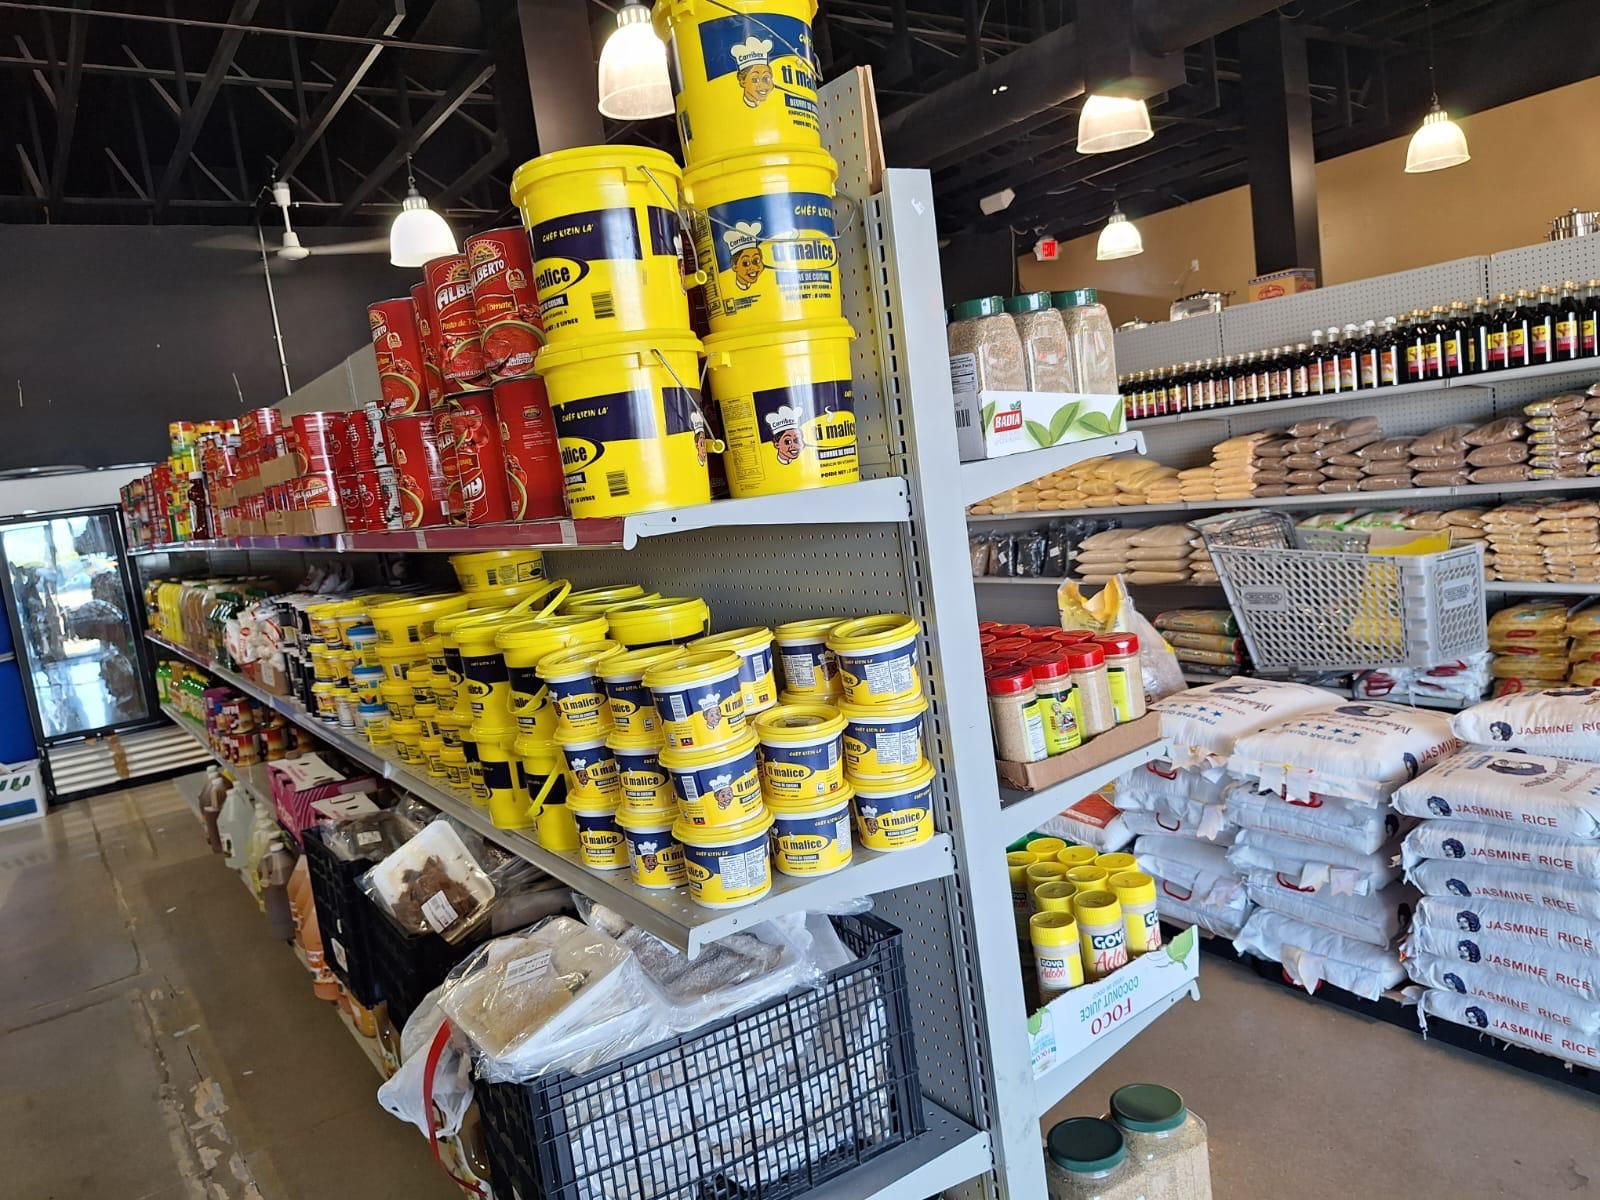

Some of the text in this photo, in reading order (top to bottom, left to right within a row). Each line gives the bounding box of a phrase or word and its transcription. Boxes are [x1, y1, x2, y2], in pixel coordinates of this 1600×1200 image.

[781, 65, 793, 84] ti
[795, 205, 816, 215] CHEF
[542, 232, 557, 242] CHEF
[559, 227, 580, 238] KIZIN
[562, 414, 575, 422] CHEF
[995, 414, 1020, 428] BADIA
[570, 697, 600, 710] malice
[1517, 722, 1600, 735] JASMINE RIC
[1421, 738, 1462, 764] JASMINE
[629, 776, 659, 786] malice
[774, 768, 804, 778] malice
[883, 813, 920, 827] ti malice
[1455, 804, 1558, 827] JASMINE RICE
[588, 834, 618, 845] malice
[790, 838, 822, 849] malice
[1470, 848, 1574, 870] JASMINE RICE
[1475, 887, 1577, 912] JASMINE RICE
[1486, 921, 1593, 950] JASMINE RICE
[1041, 968, 1065, 978] Adobo
[1485, 954, 1592, 991] JASMINE RICE
[1104, 976, 1139, 1005] COCONUT
[1080, 1000, 1101, 1022] JUICE
[1470, 988, 1572, 1025] JASMINE RICE
[1091, 998, 1131, 1035] FOCO
[1492, 1019, 1597, 1057] JASMINE RICE
